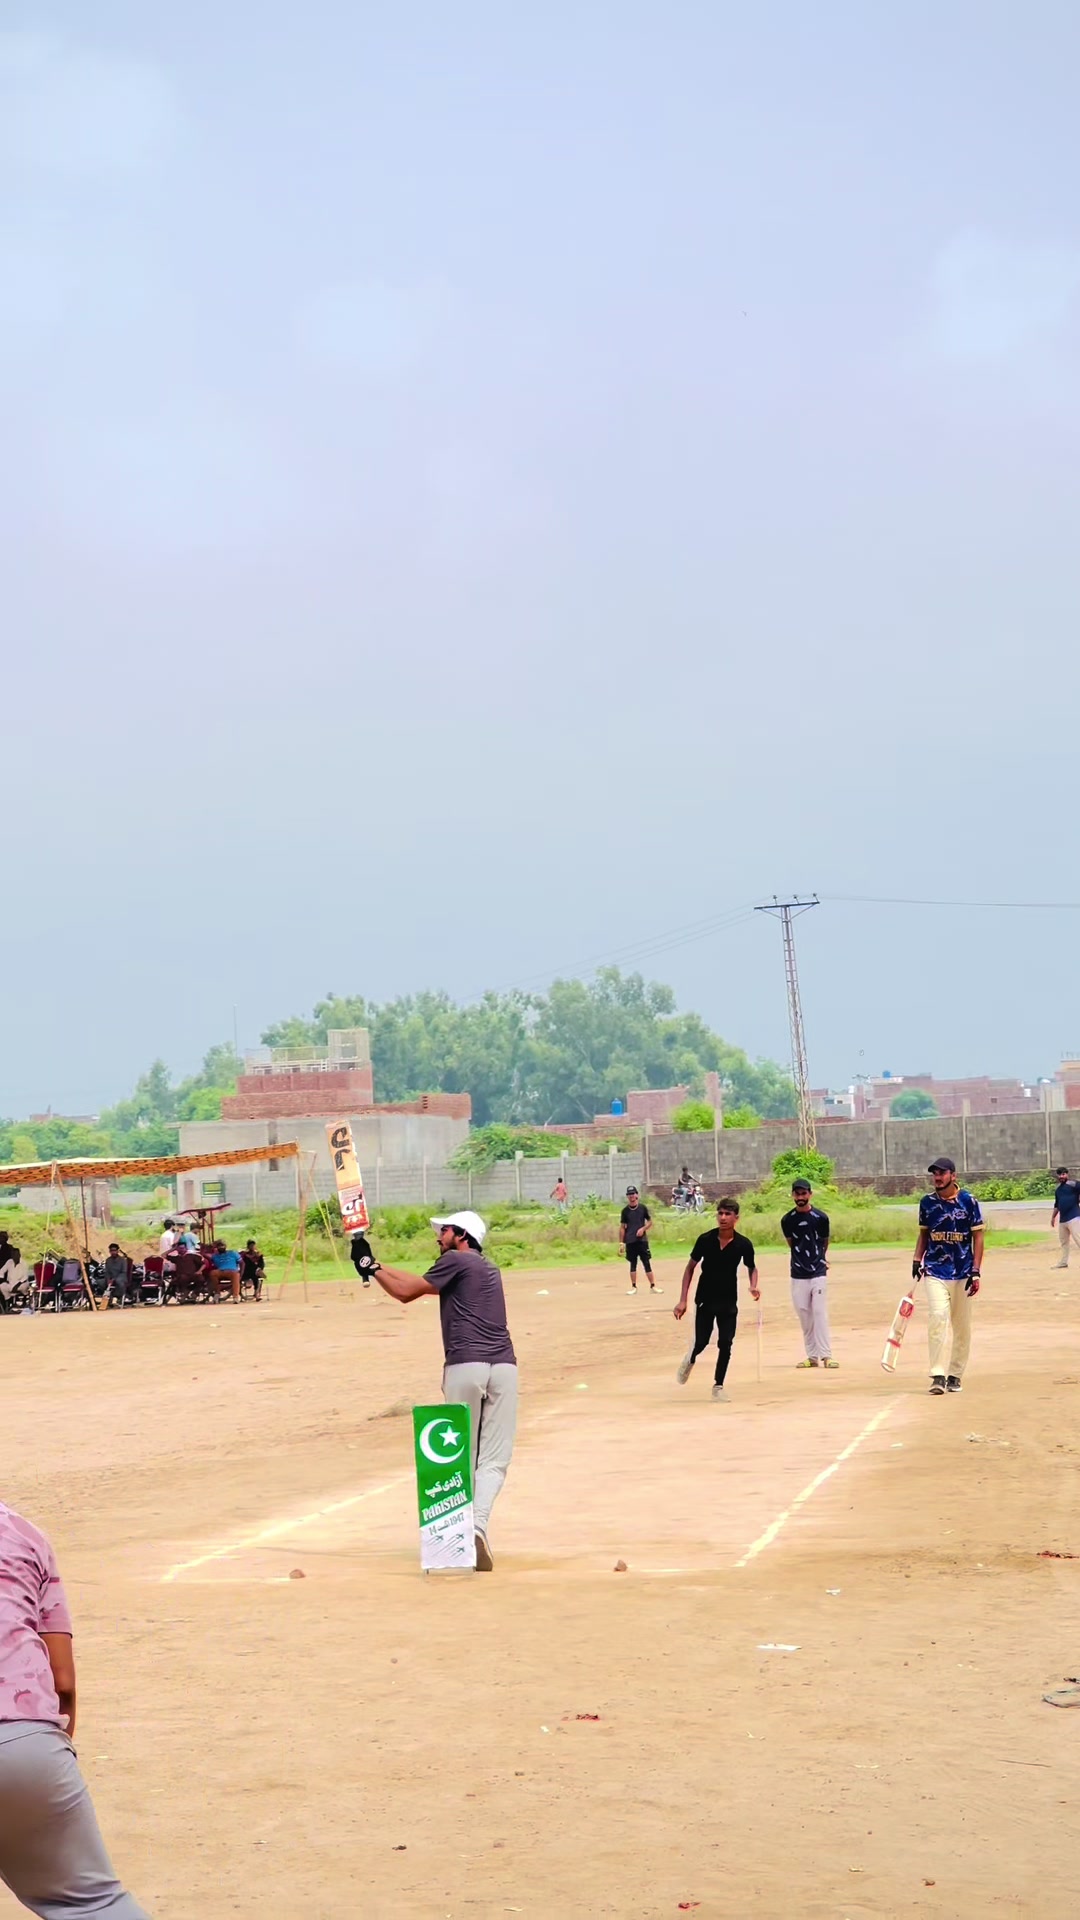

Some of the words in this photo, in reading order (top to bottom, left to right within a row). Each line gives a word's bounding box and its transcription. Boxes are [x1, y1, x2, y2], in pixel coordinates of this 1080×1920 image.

[425, 1481, 442, 1498] کپ
[442, 1471, 463, 1491] آزادی
[422, 1489, 467, 1521] PAKISTAN
[429, 1525, 438, 1535] 14
[449, 1512, 465, 1526] 1947
